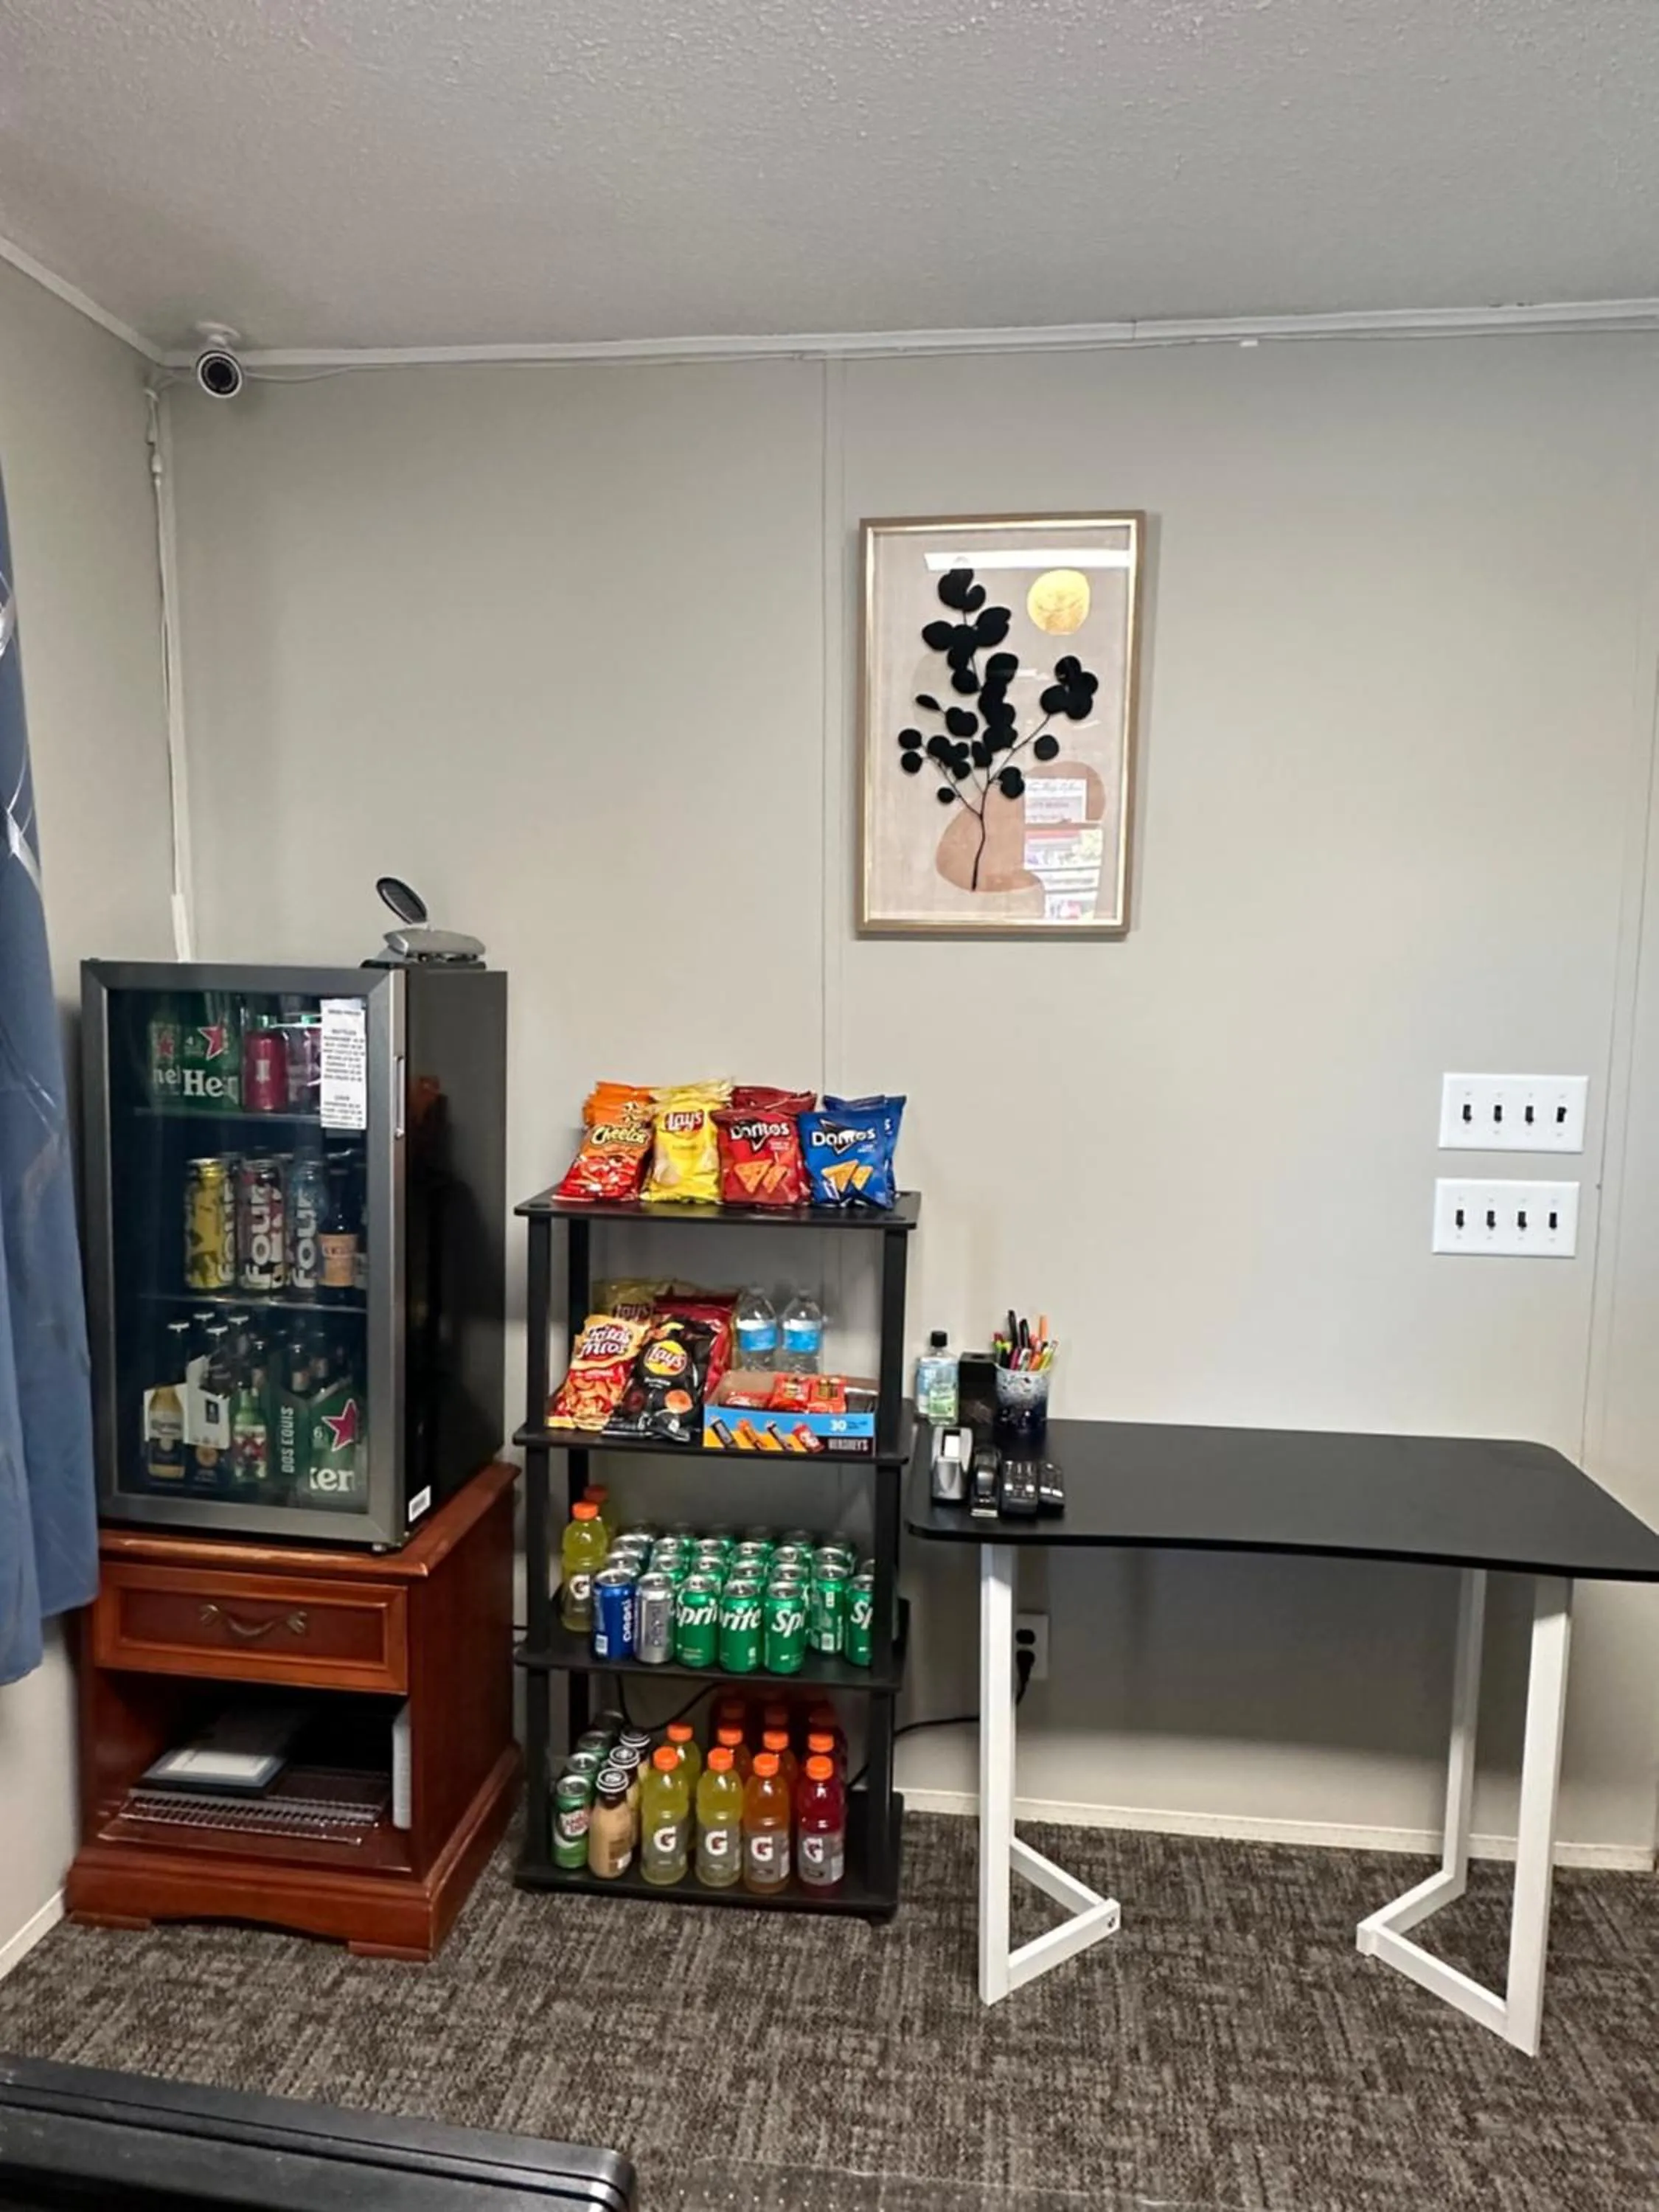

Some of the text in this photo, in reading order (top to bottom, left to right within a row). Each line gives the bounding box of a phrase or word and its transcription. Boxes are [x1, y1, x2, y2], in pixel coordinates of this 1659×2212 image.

[731, 1122, 790, 1140] Doritos
[812, 1127, 876, 1147] Doritos
[281, 1406, 294, 1473] DOS EQUIS
[720, 1606, 761, 1631] rite
[653, 1826, 677, 1853] G
[705, 1829, 728, 1856] G
[751, 1836, 773, 1862] G
[803, 1837, 824, 1863] G
